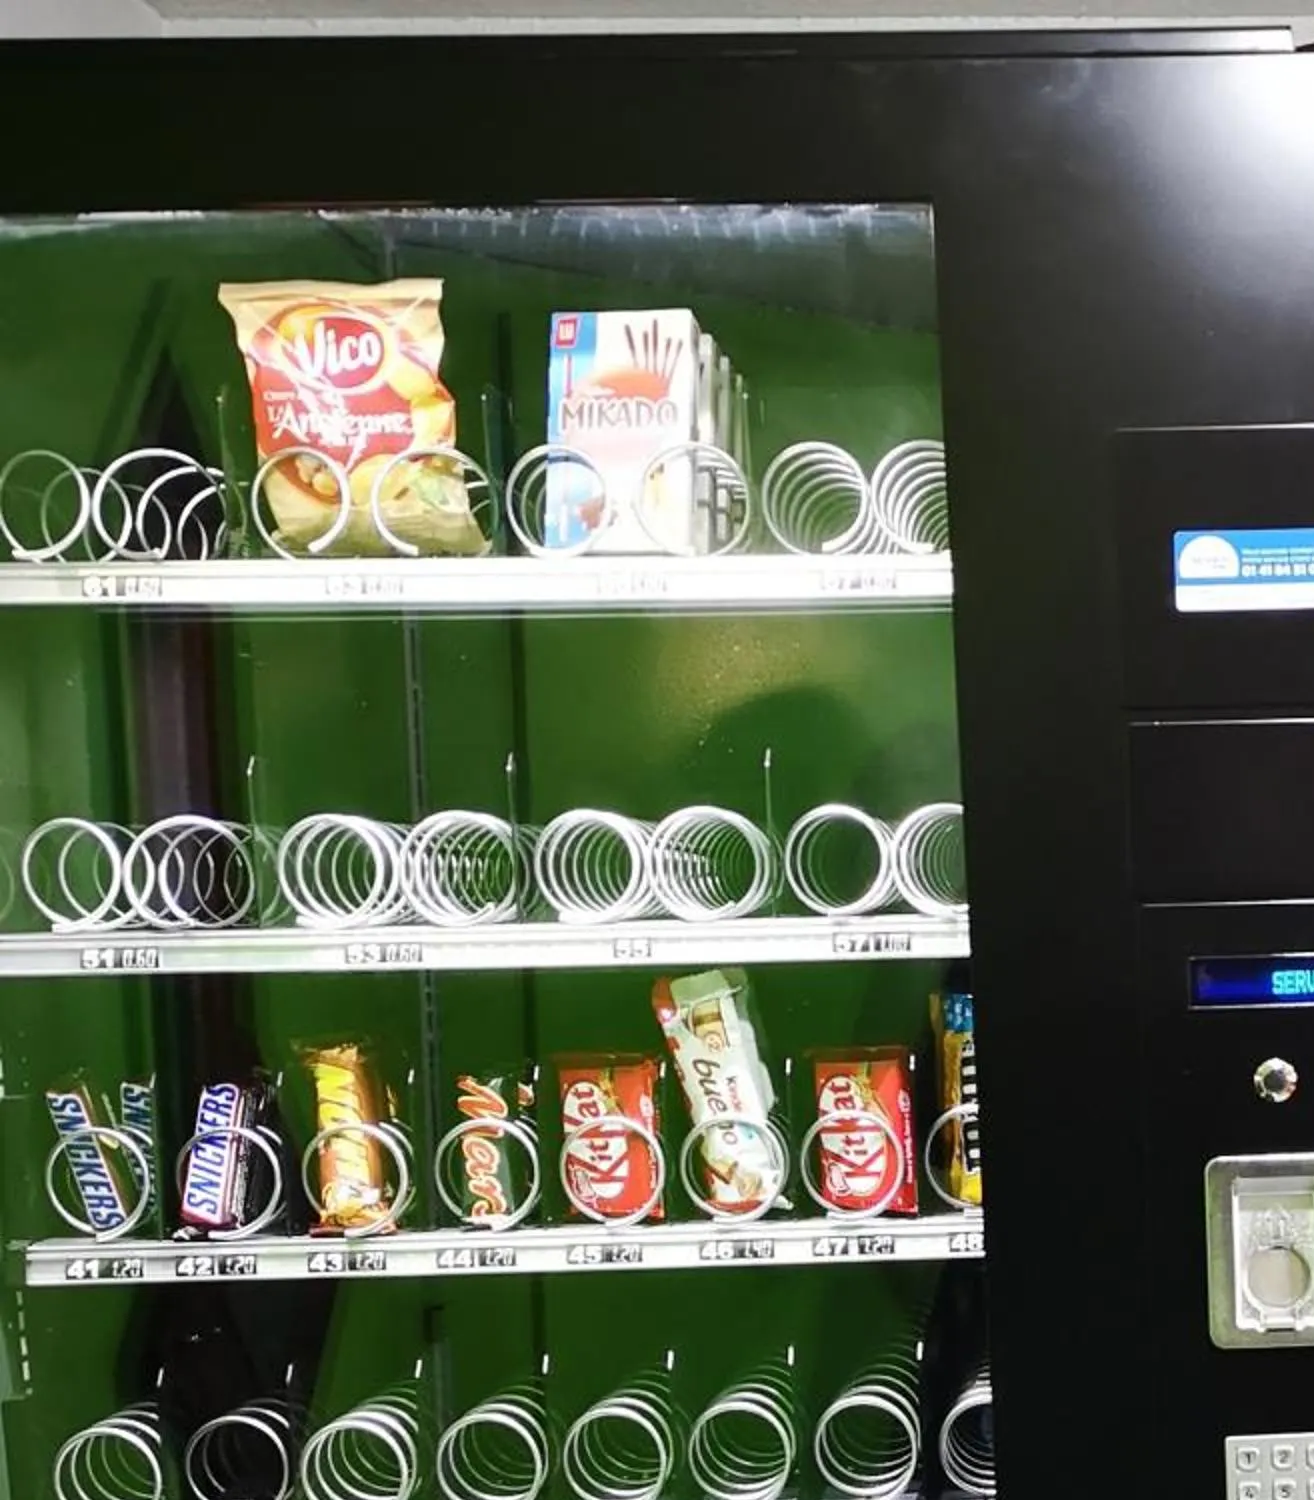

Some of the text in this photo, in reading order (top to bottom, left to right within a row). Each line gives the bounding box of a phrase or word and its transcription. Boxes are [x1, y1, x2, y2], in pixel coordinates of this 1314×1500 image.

[292, 319, 381, 376] Vico
[562, 400, 678, 430] MIKADO
[82, 949, 113, 968] 51
[187, 1083, 239, 1215] SNICKERS
[700, 1241, 735, 1259] 46
[814, 1237, 848, 1255] 47
[951, 1233, 984, 1251] 48
[309, 1252, 344, 1272] 43
[438, 1249, 474, 1268] 44
[568, 1245, 603, 1264] 45
[68, 1259, 99, 1279] 41
[177, 1256, 214, 1276] 42
